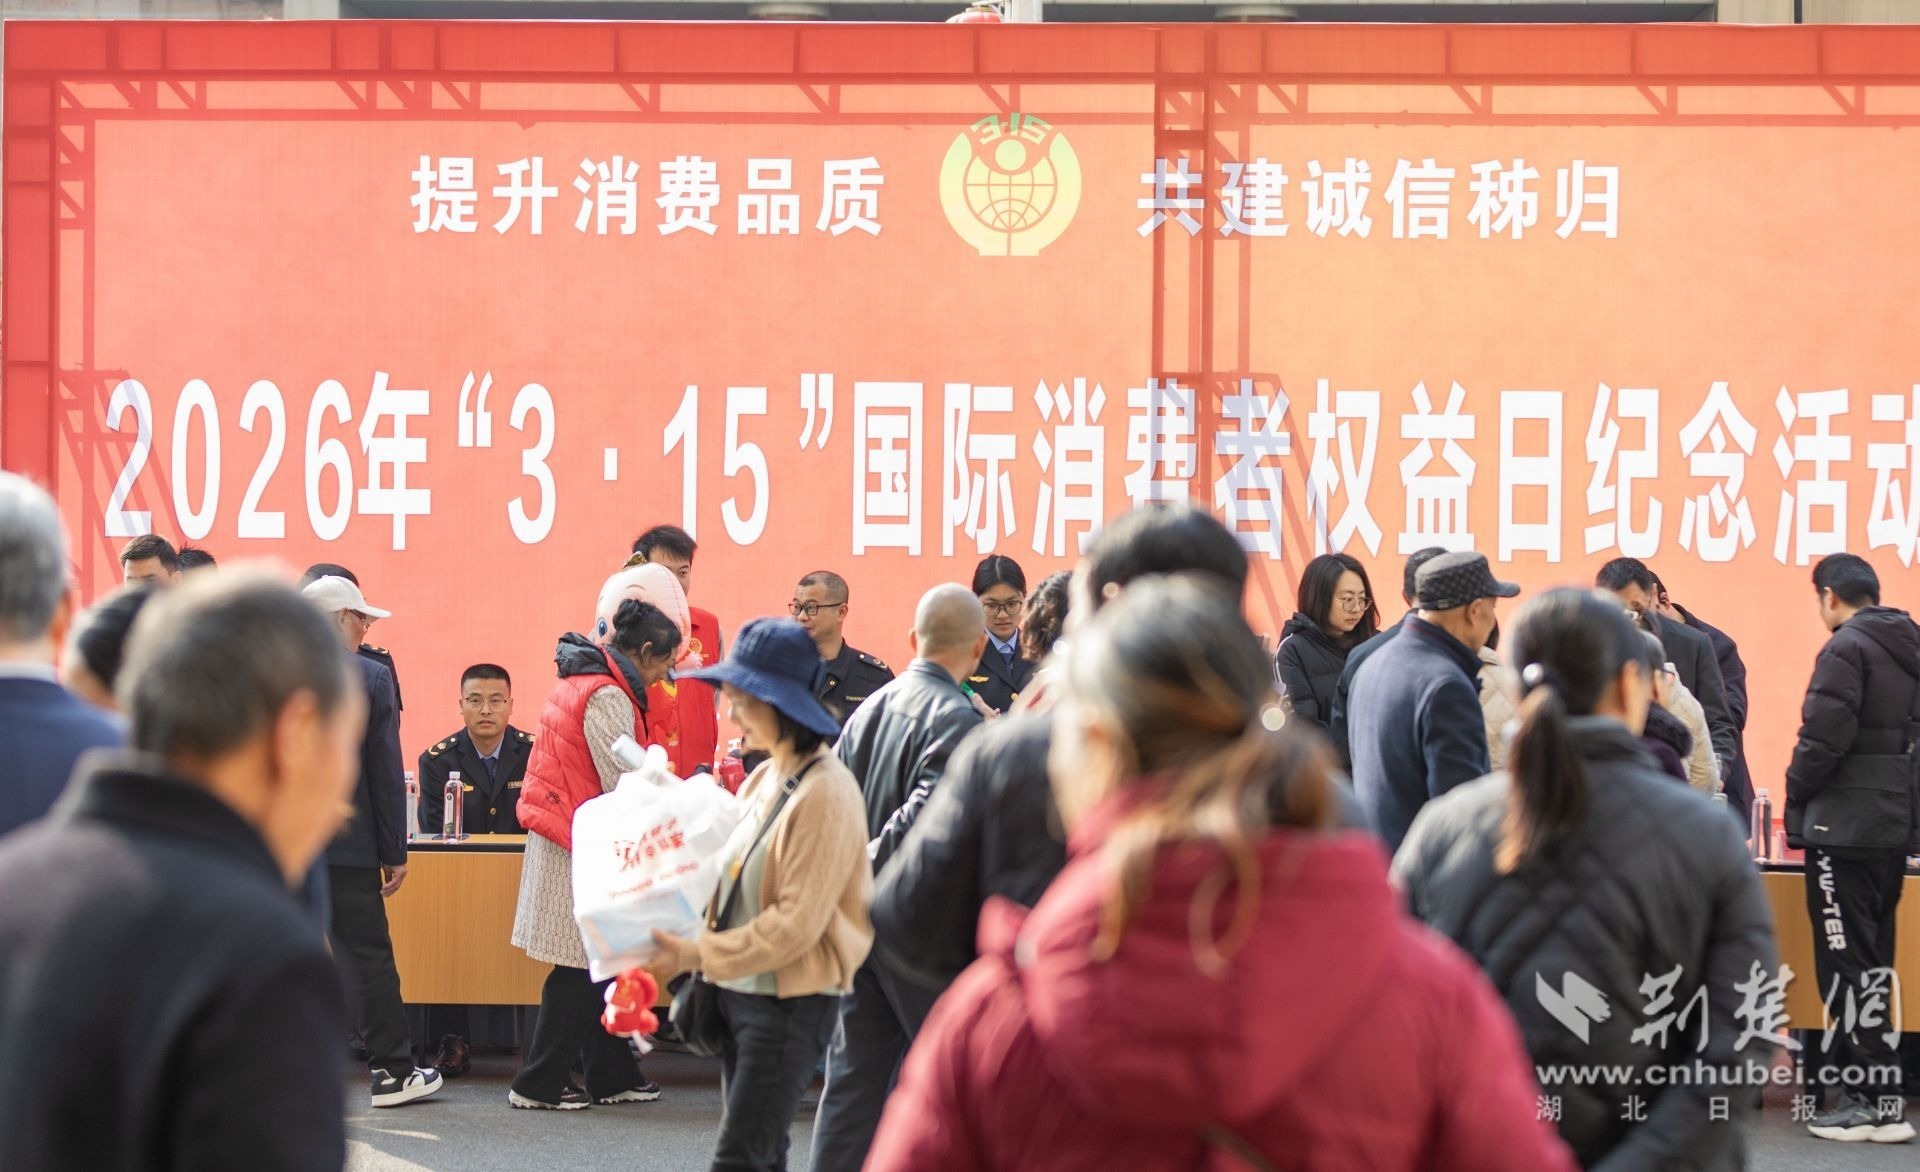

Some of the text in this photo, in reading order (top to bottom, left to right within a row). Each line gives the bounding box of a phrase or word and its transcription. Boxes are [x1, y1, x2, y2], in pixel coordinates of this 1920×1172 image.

[411, 155, 884, 236] 提升消费品质
[1137, 158, 1620, 240] 共建诚信秭归
